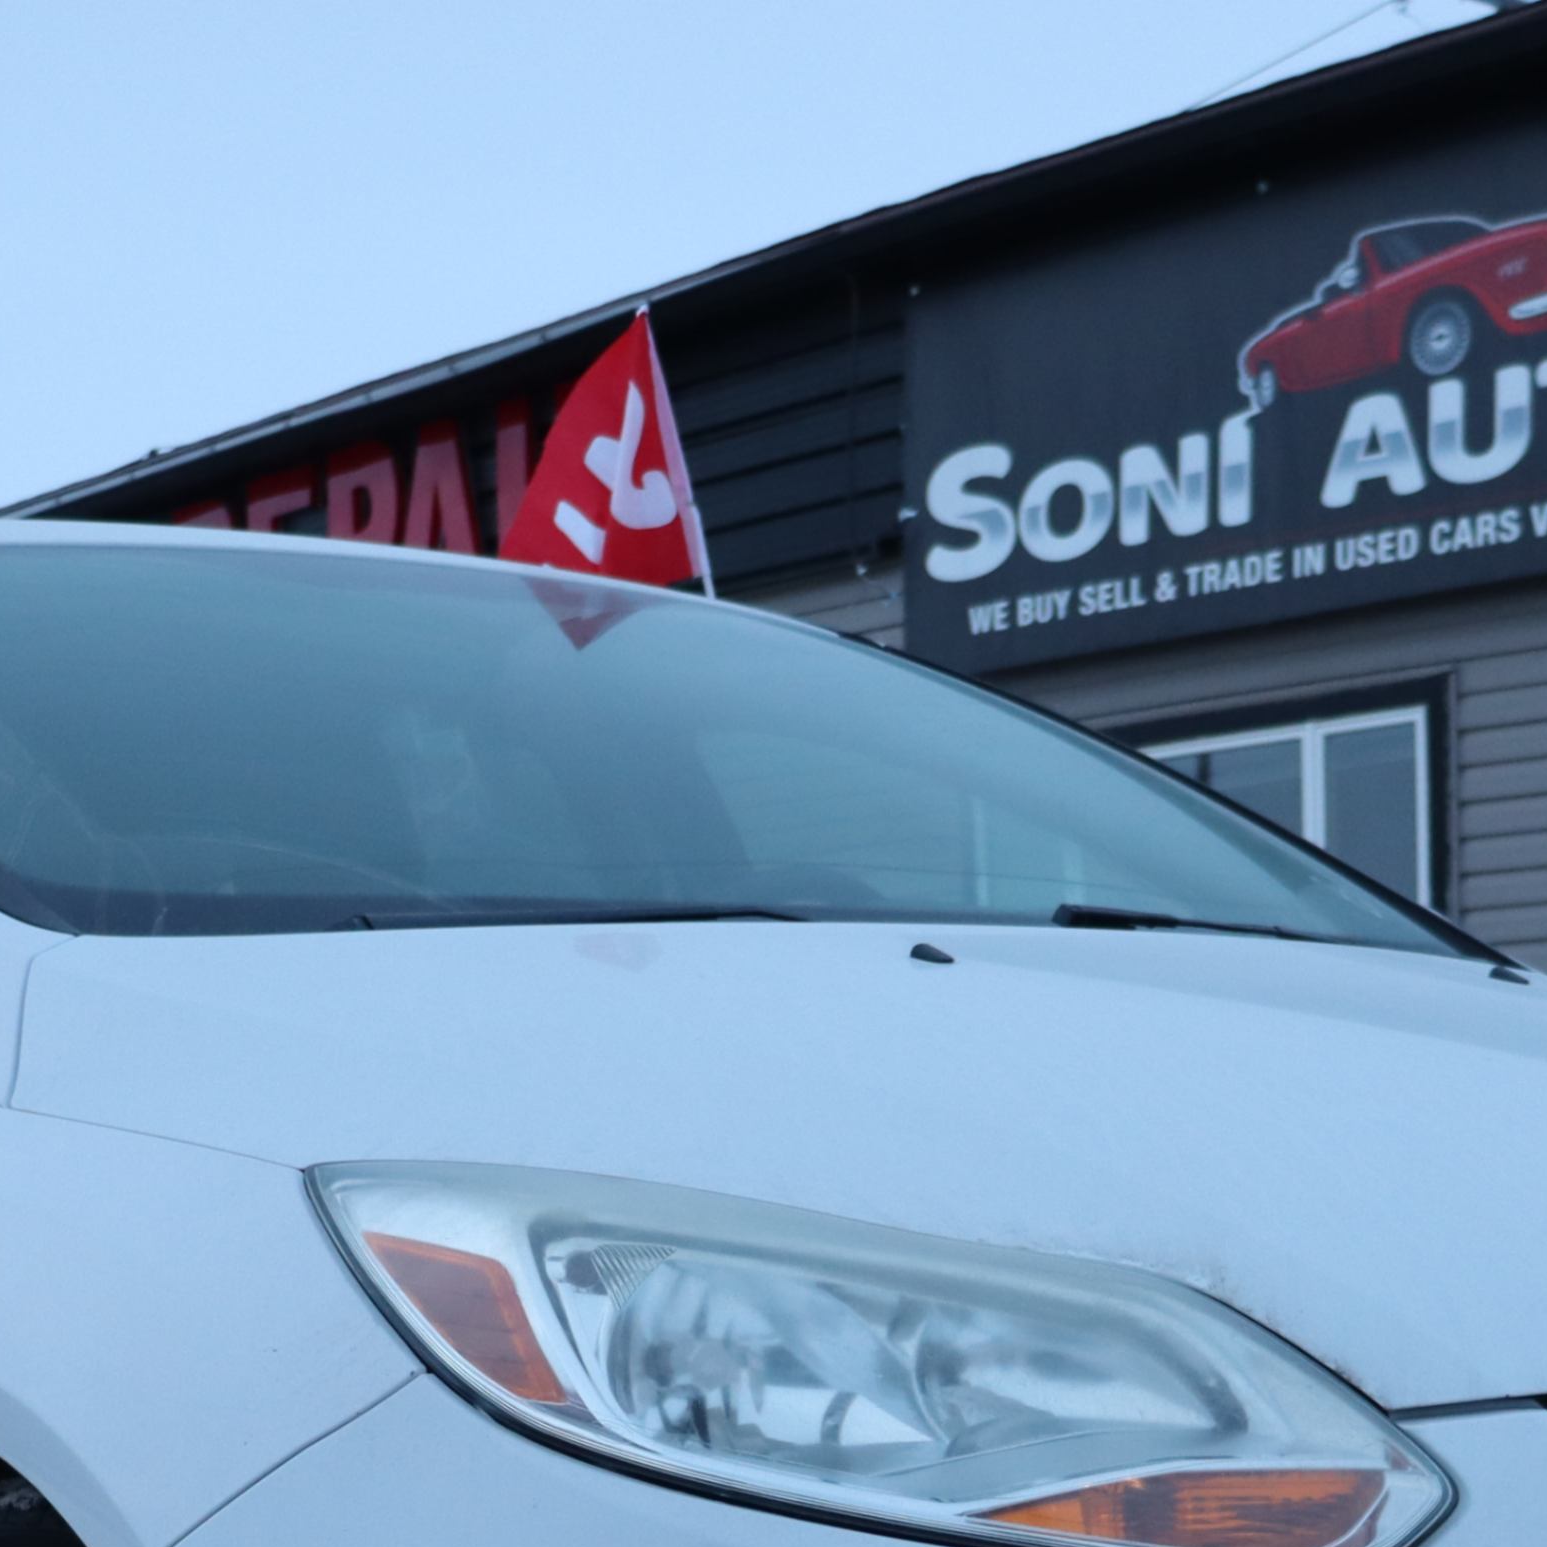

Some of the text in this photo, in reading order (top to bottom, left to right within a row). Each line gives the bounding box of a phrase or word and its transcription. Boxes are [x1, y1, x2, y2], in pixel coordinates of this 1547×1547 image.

[967, 600, 1009, 636] WE
[1016, 589, 1073, 627] BUY
[1078, 575, 1147, 616] SELL
[1154, 570, 1179, 603] &
[1184, 551, 1284, 597] TRADE
[1292, 543, 1328, 579] IN
[1335, 526, 1420, 572] USED
[1429, 509, 1522, 556] CARS
